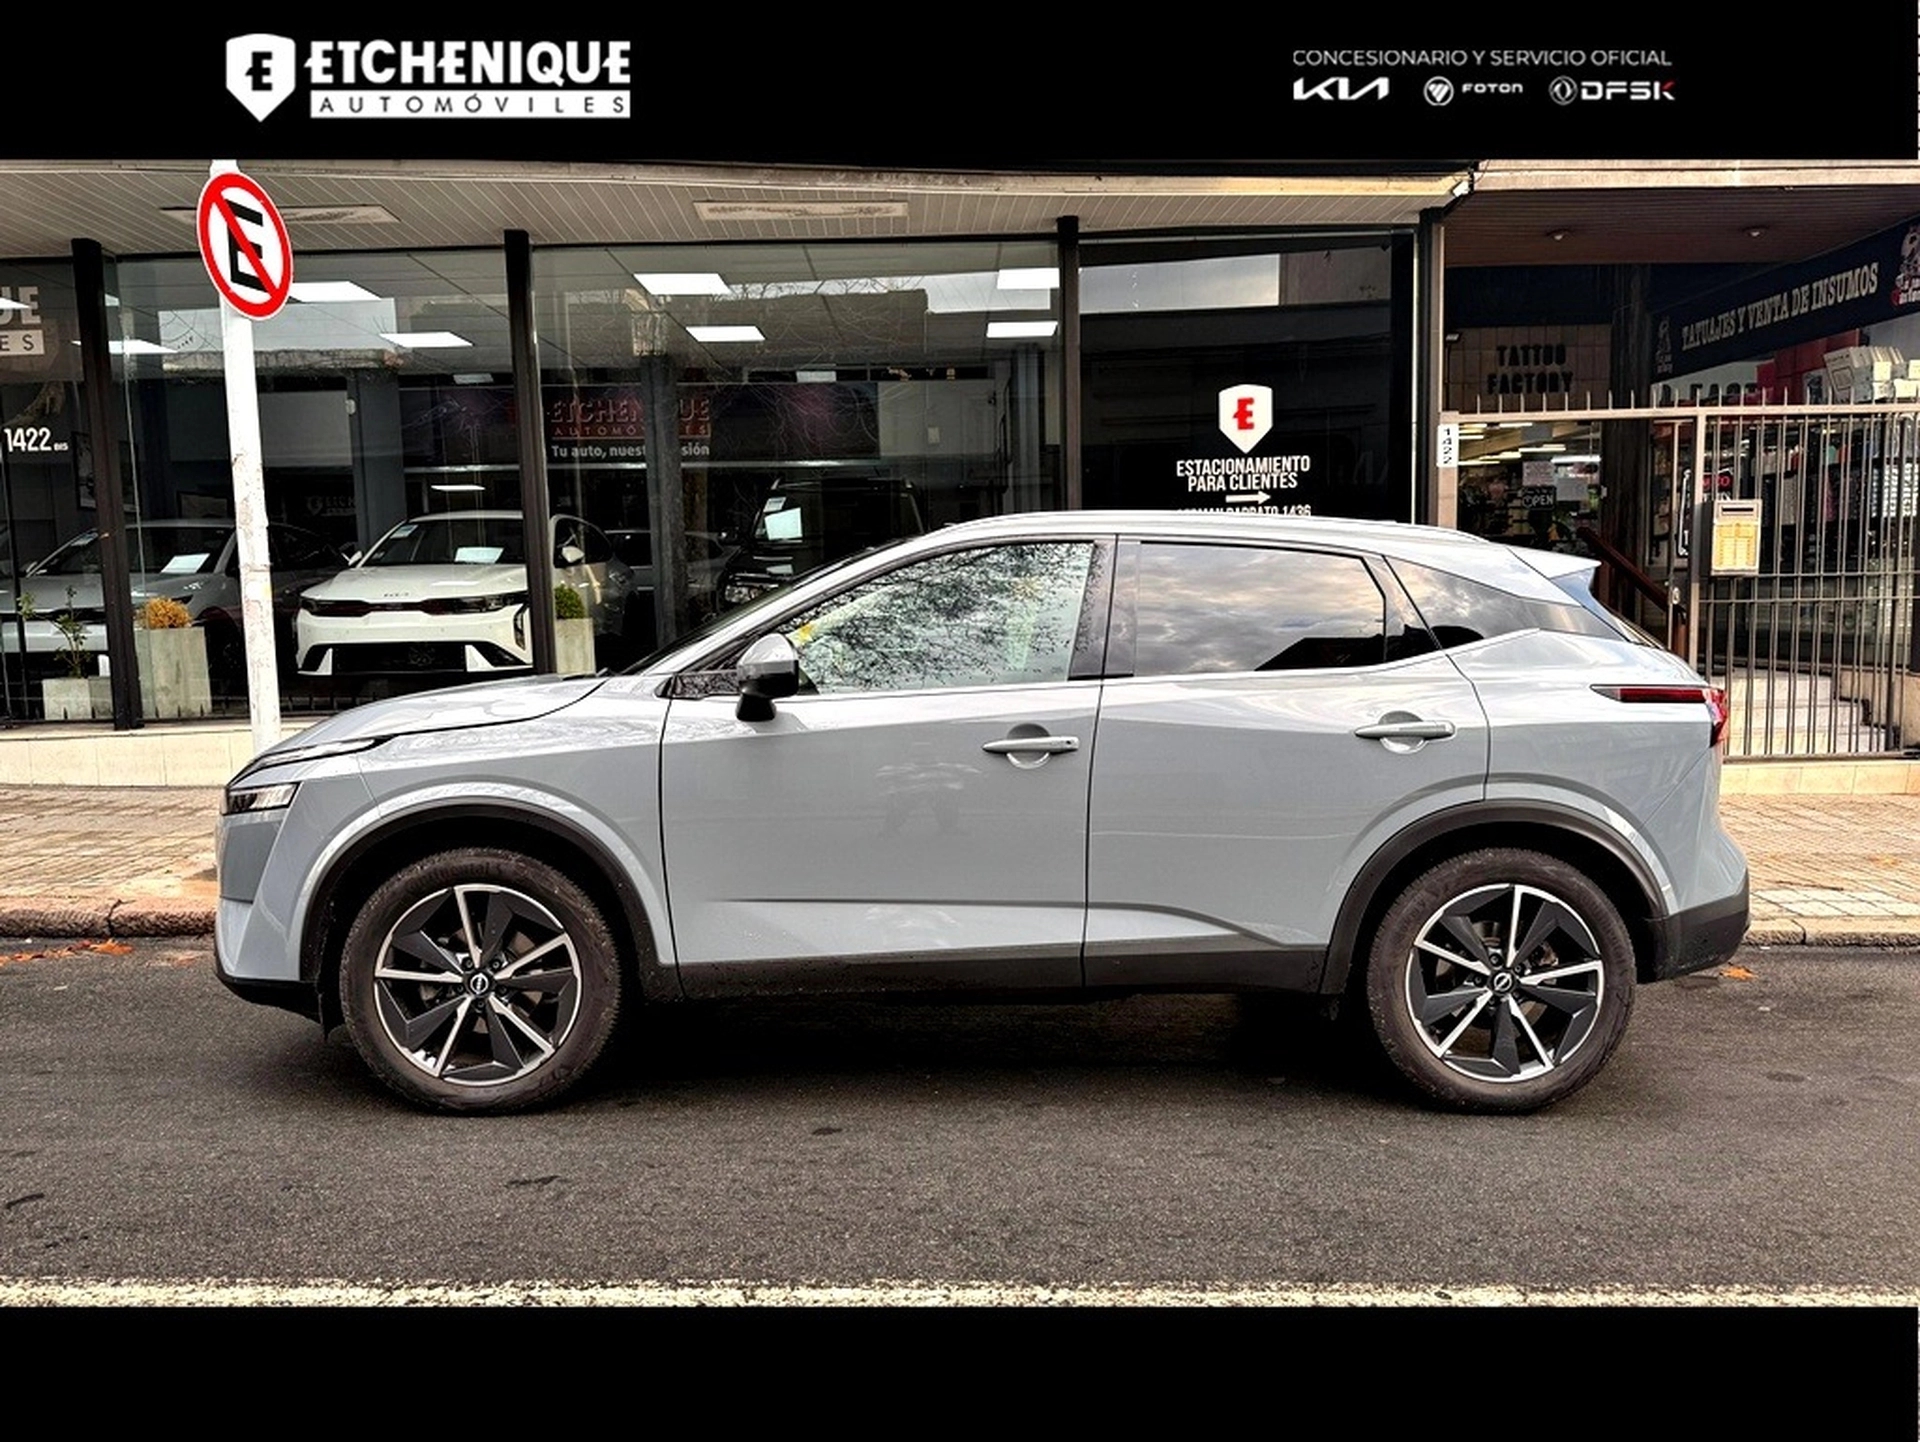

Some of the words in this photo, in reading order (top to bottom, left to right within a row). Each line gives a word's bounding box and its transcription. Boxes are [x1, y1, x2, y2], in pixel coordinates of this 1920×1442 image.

[1681, 310, 1737, 350] TATUAJES
[1735, 304, 1749, 333] Y
[1748, 291, 1790, 330] VENTA
[1790, 282, 1811, 317] DE
[1811, 261, 1880, 311] INSUMOS
[1496, 344, 1567, 367] TATTOO
[1487, 371, 1574, 395] FACTORY
[3, 427, 52, 452] 1422
[551, 445, 568, 457] Tu
[571, 445, 607, 459] auto,
[1176, 455, 1311, 477] ESTACIONAMIENTO
[1188, 475, 1227, 492] PARA
[1229, 472, 1298, 490] CLIENTES
[1522, 494, 1554, 509] OPEN
